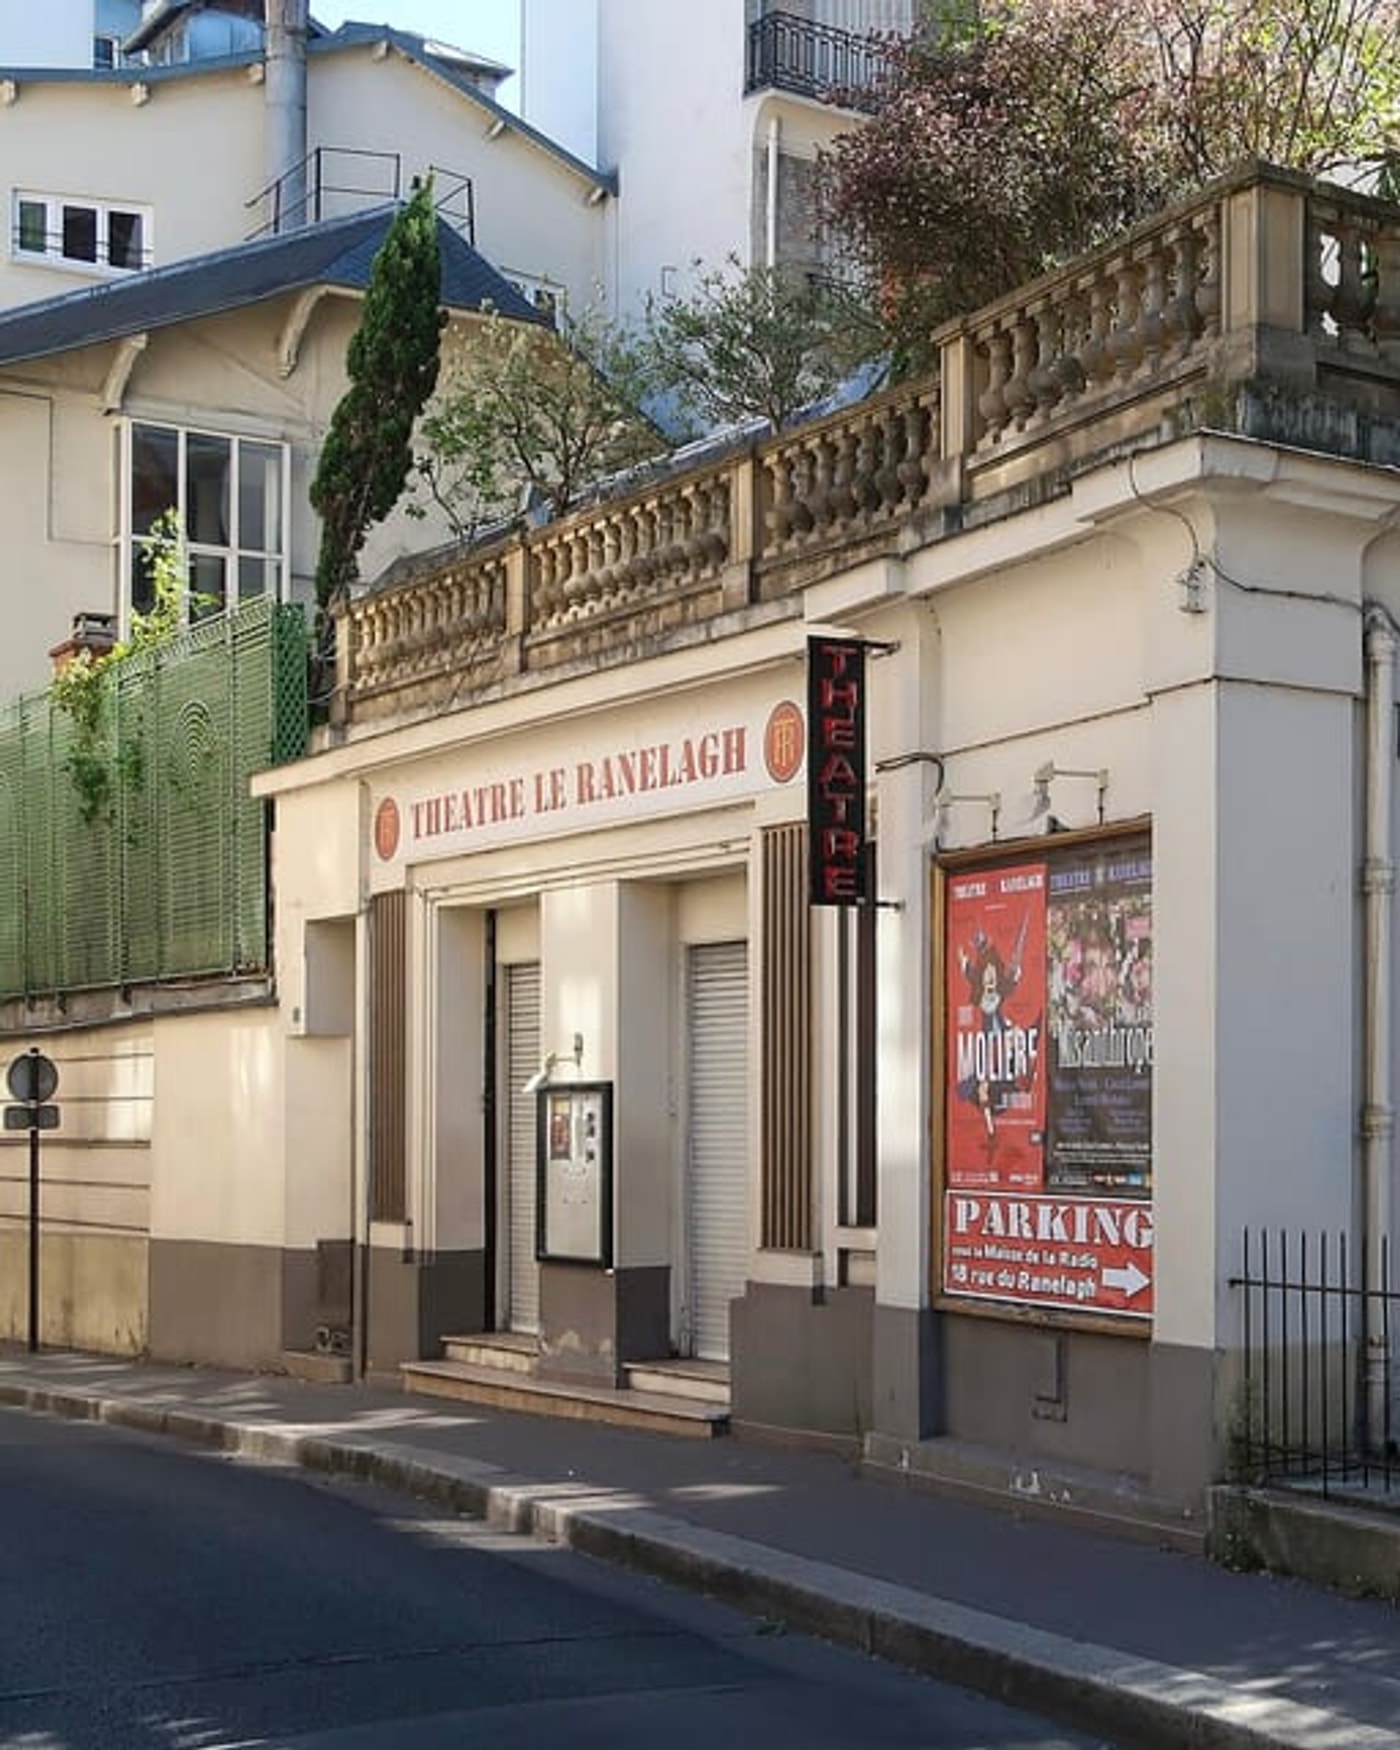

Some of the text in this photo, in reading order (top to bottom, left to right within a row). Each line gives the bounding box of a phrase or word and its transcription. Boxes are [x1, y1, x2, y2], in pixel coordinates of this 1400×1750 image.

[411, 778, 525, 838] THEATRE
[534, 768, 567, 814] LE
[576, 727, 747, 805] RANELAGH
[818, 645, 858, 897] THEATRE
[955, 1199, 1153, 1249] PARKING
[1025, 1249, 1040, 1265] de
[970, 1269, 994, 1287] rue
[996, 1268, 1015, 1288] du
[1017, 1271, 1096, 1300] Ranelagh
